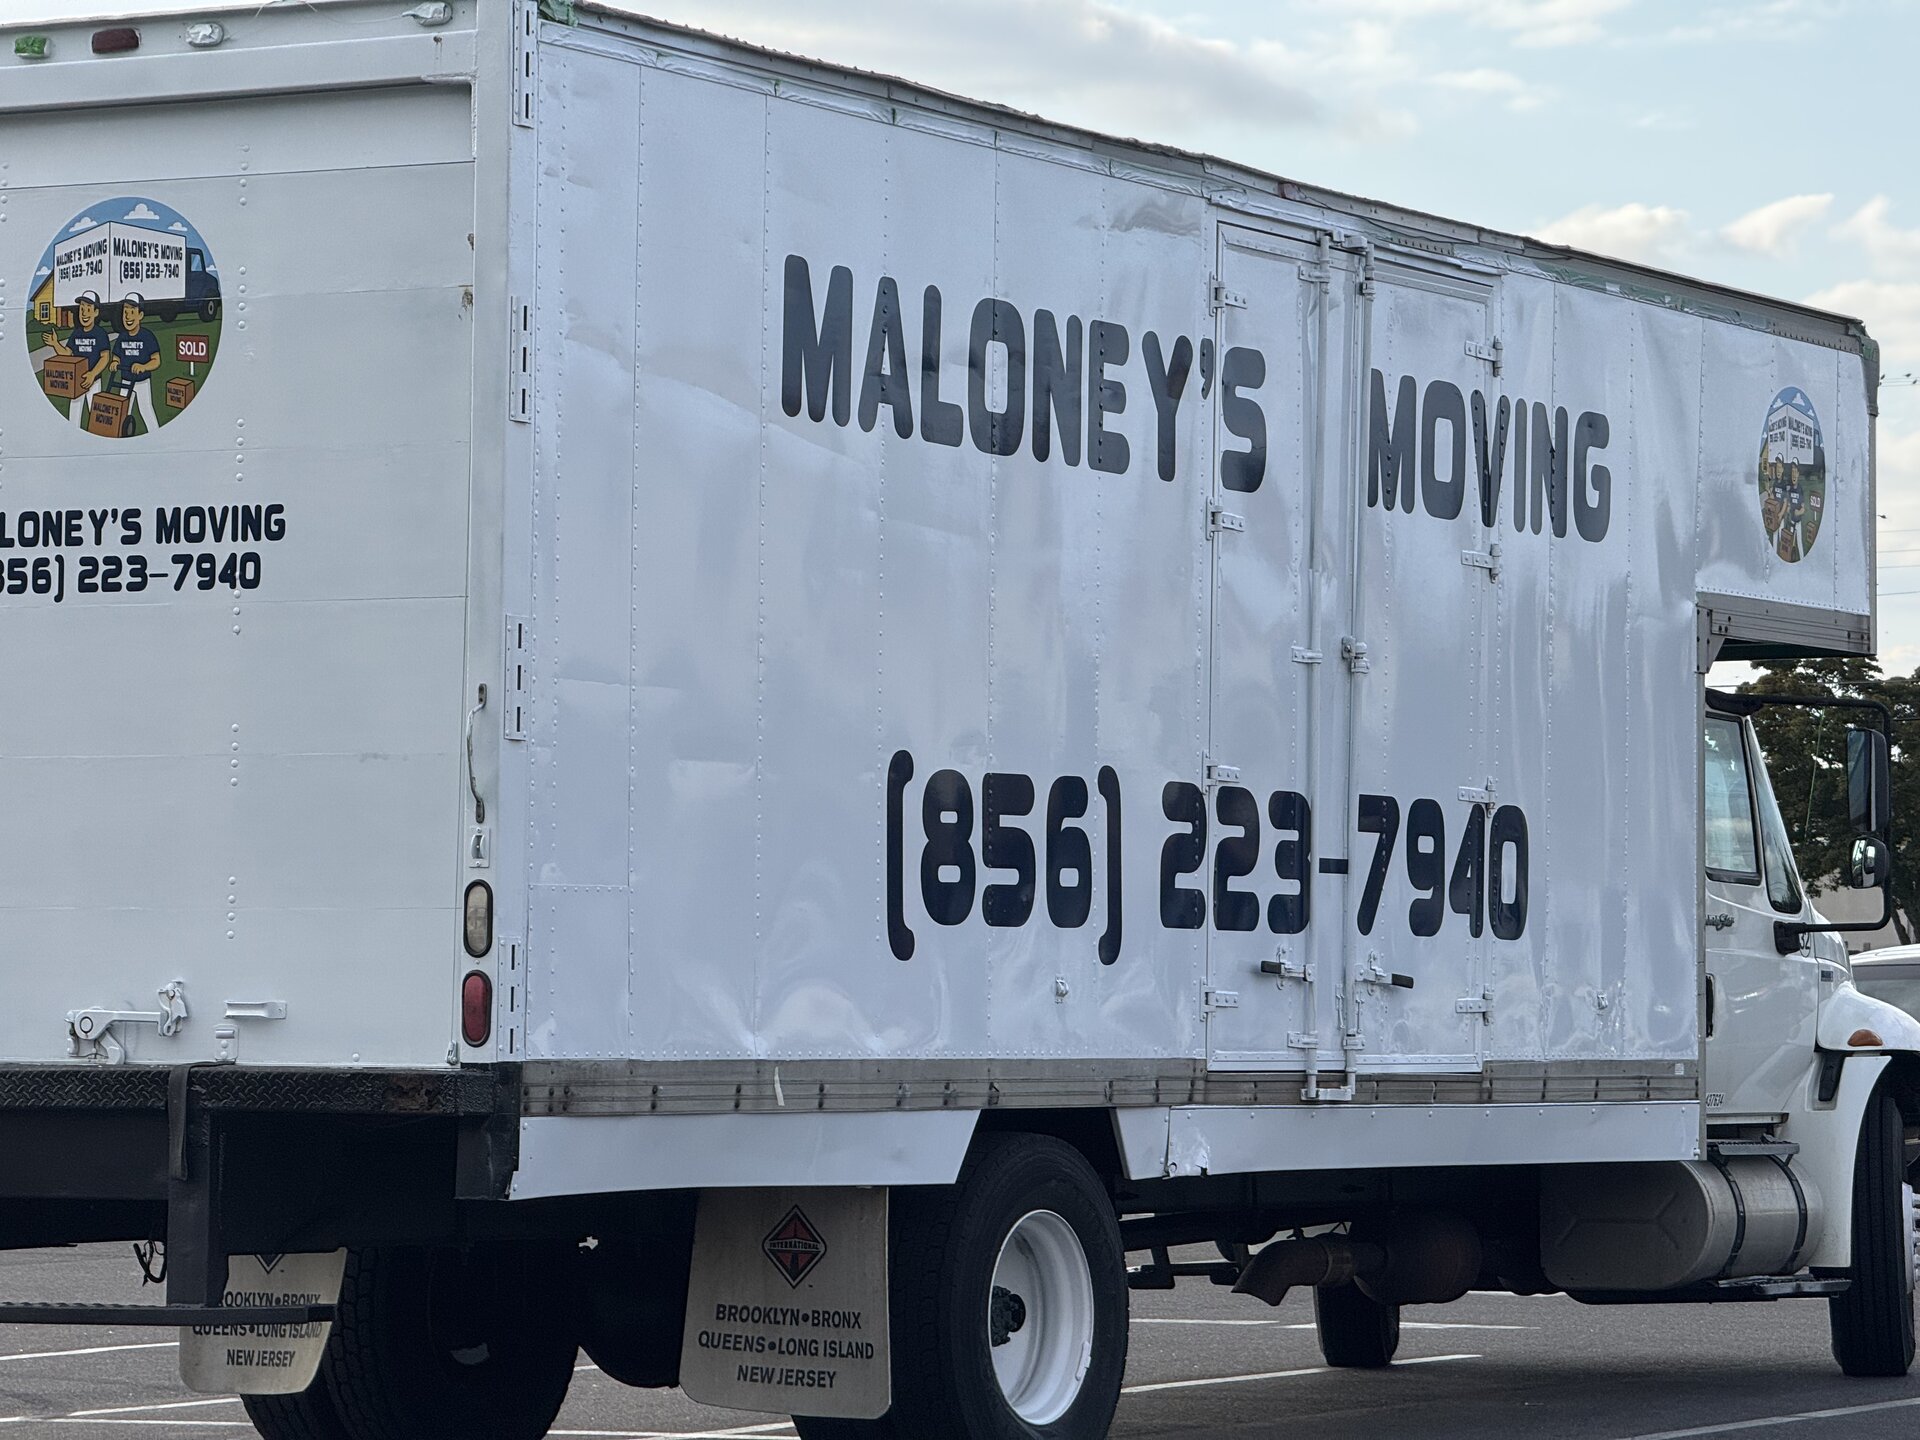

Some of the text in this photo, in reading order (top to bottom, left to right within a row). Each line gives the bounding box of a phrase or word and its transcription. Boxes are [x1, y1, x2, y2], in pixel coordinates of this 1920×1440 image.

[83, 238, 108, 260] MOVING
[113, 237, 183, 261] MALONEY'S MOVING
[119, 260, 180, 284] (856) 223-7940
[178, 340, 207, 357] SOLD
[781, 254, 1611, 543] MALONEY'S MOVING
[156, 503, 286, 544] MOVING
[0, 551, 261, 603] 56) 223-7940
[886, 749, 1528, 966] (856) 223-7940
[769, 1240, 820, 1250] INTERNATIONAL
[221, 1291, 274, 1308] OOKLYN
[226, 1349, 296, 1368] NEW JERSEY
[823, 1340, 874, 1360] ISLAND
[737, 1365, 837, 1389] NEW JERSEY
